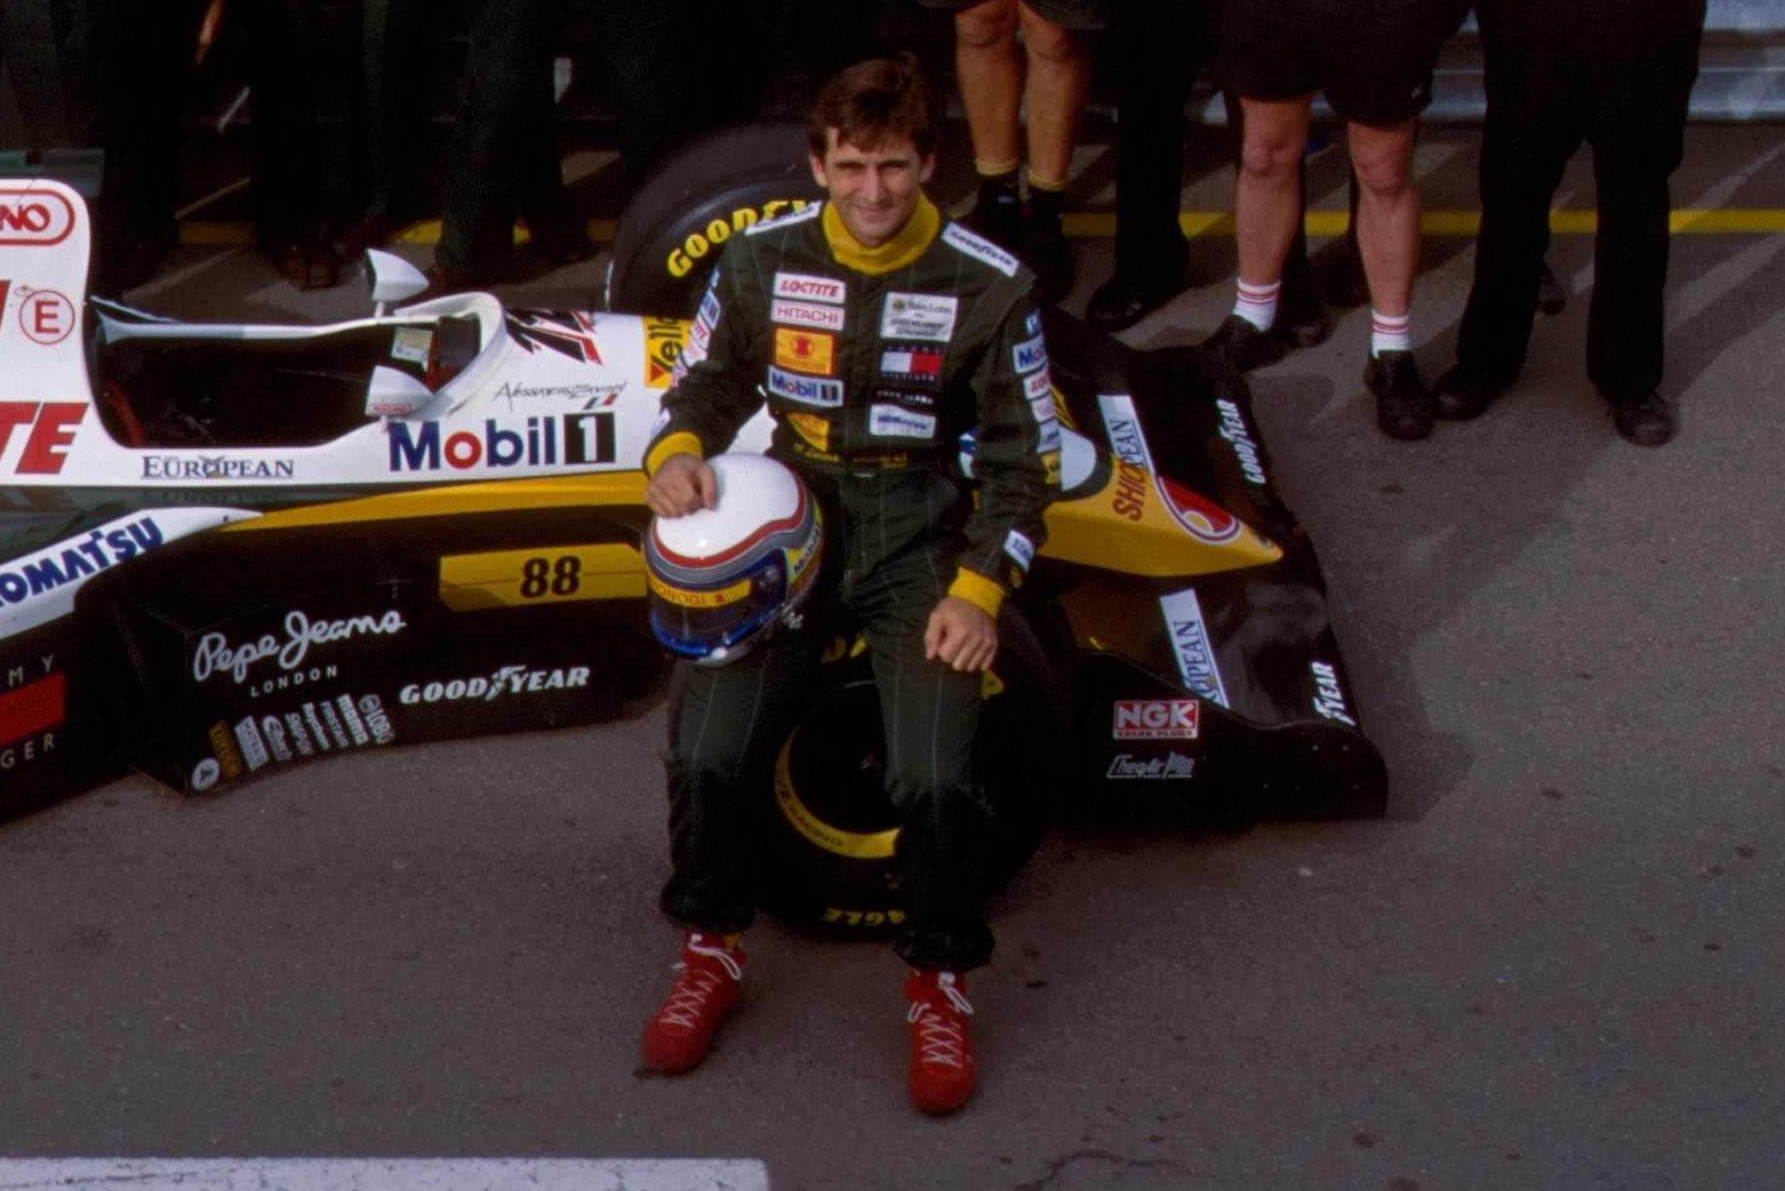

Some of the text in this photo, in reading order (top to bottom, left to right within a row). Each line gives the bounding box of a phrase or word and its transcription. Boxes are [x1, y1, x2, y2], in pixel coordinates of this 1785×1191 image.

[780, 280, 840, 298] LOCTITE
[777, 307, 838, 324] HITACHI
[647, 312, 685, 382] Yello
[772, 373, 818, 398] Mobil
[388, 416, 557, 472] Mobil
[1216, 399, 1267, 484] GOODYEAR
[1112, 459, 1148, 521] SHIO
[520, 556, 582, 598] 88
[194, 610, 406, 684] Pepe Jeans
[250, 665, 339, 698] LONDON
[399, 665, 590, 704] GOODYEAR
[1312, 662, 1352, 722] YEAR
[1117, 704, 1194, 728] NGK
[821, 907, 906, 927] AGLE
